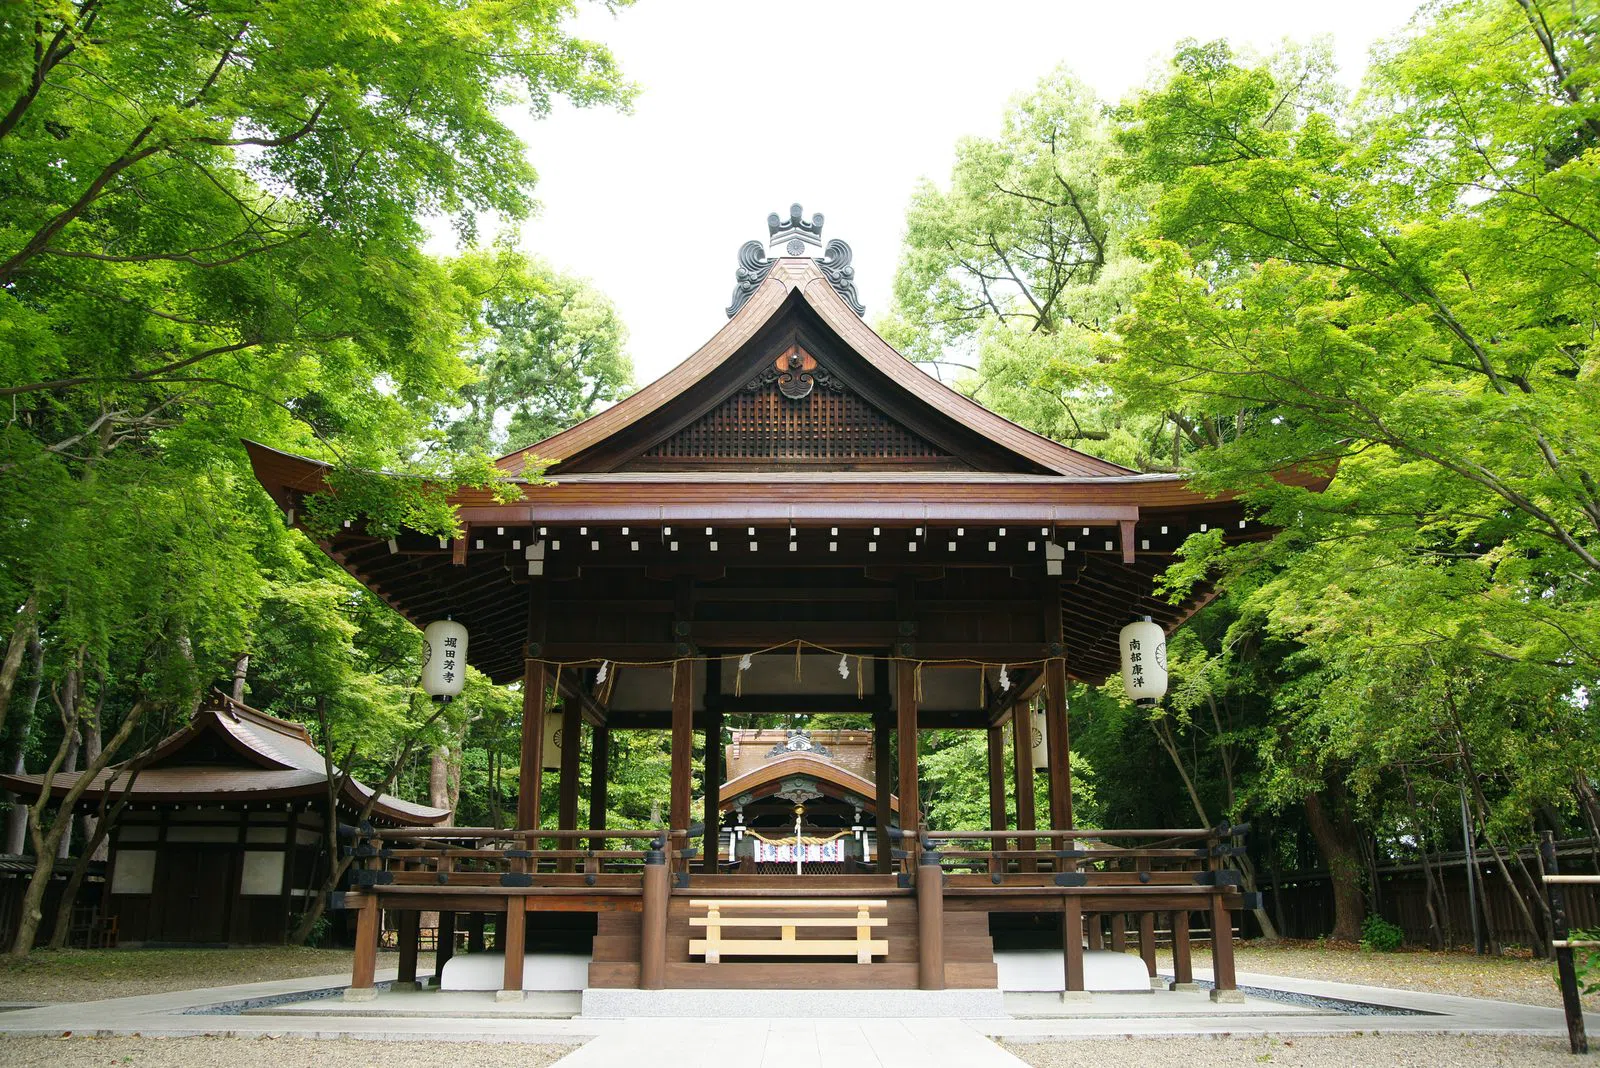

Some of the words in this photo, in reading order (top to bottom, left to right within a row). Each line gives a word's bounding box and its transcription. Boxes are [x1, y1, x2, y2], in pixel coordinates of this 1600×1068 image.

[442, 636, 457, 684] 堀田芳孝
[1129, 638, 1145, 688] 南部康洋
